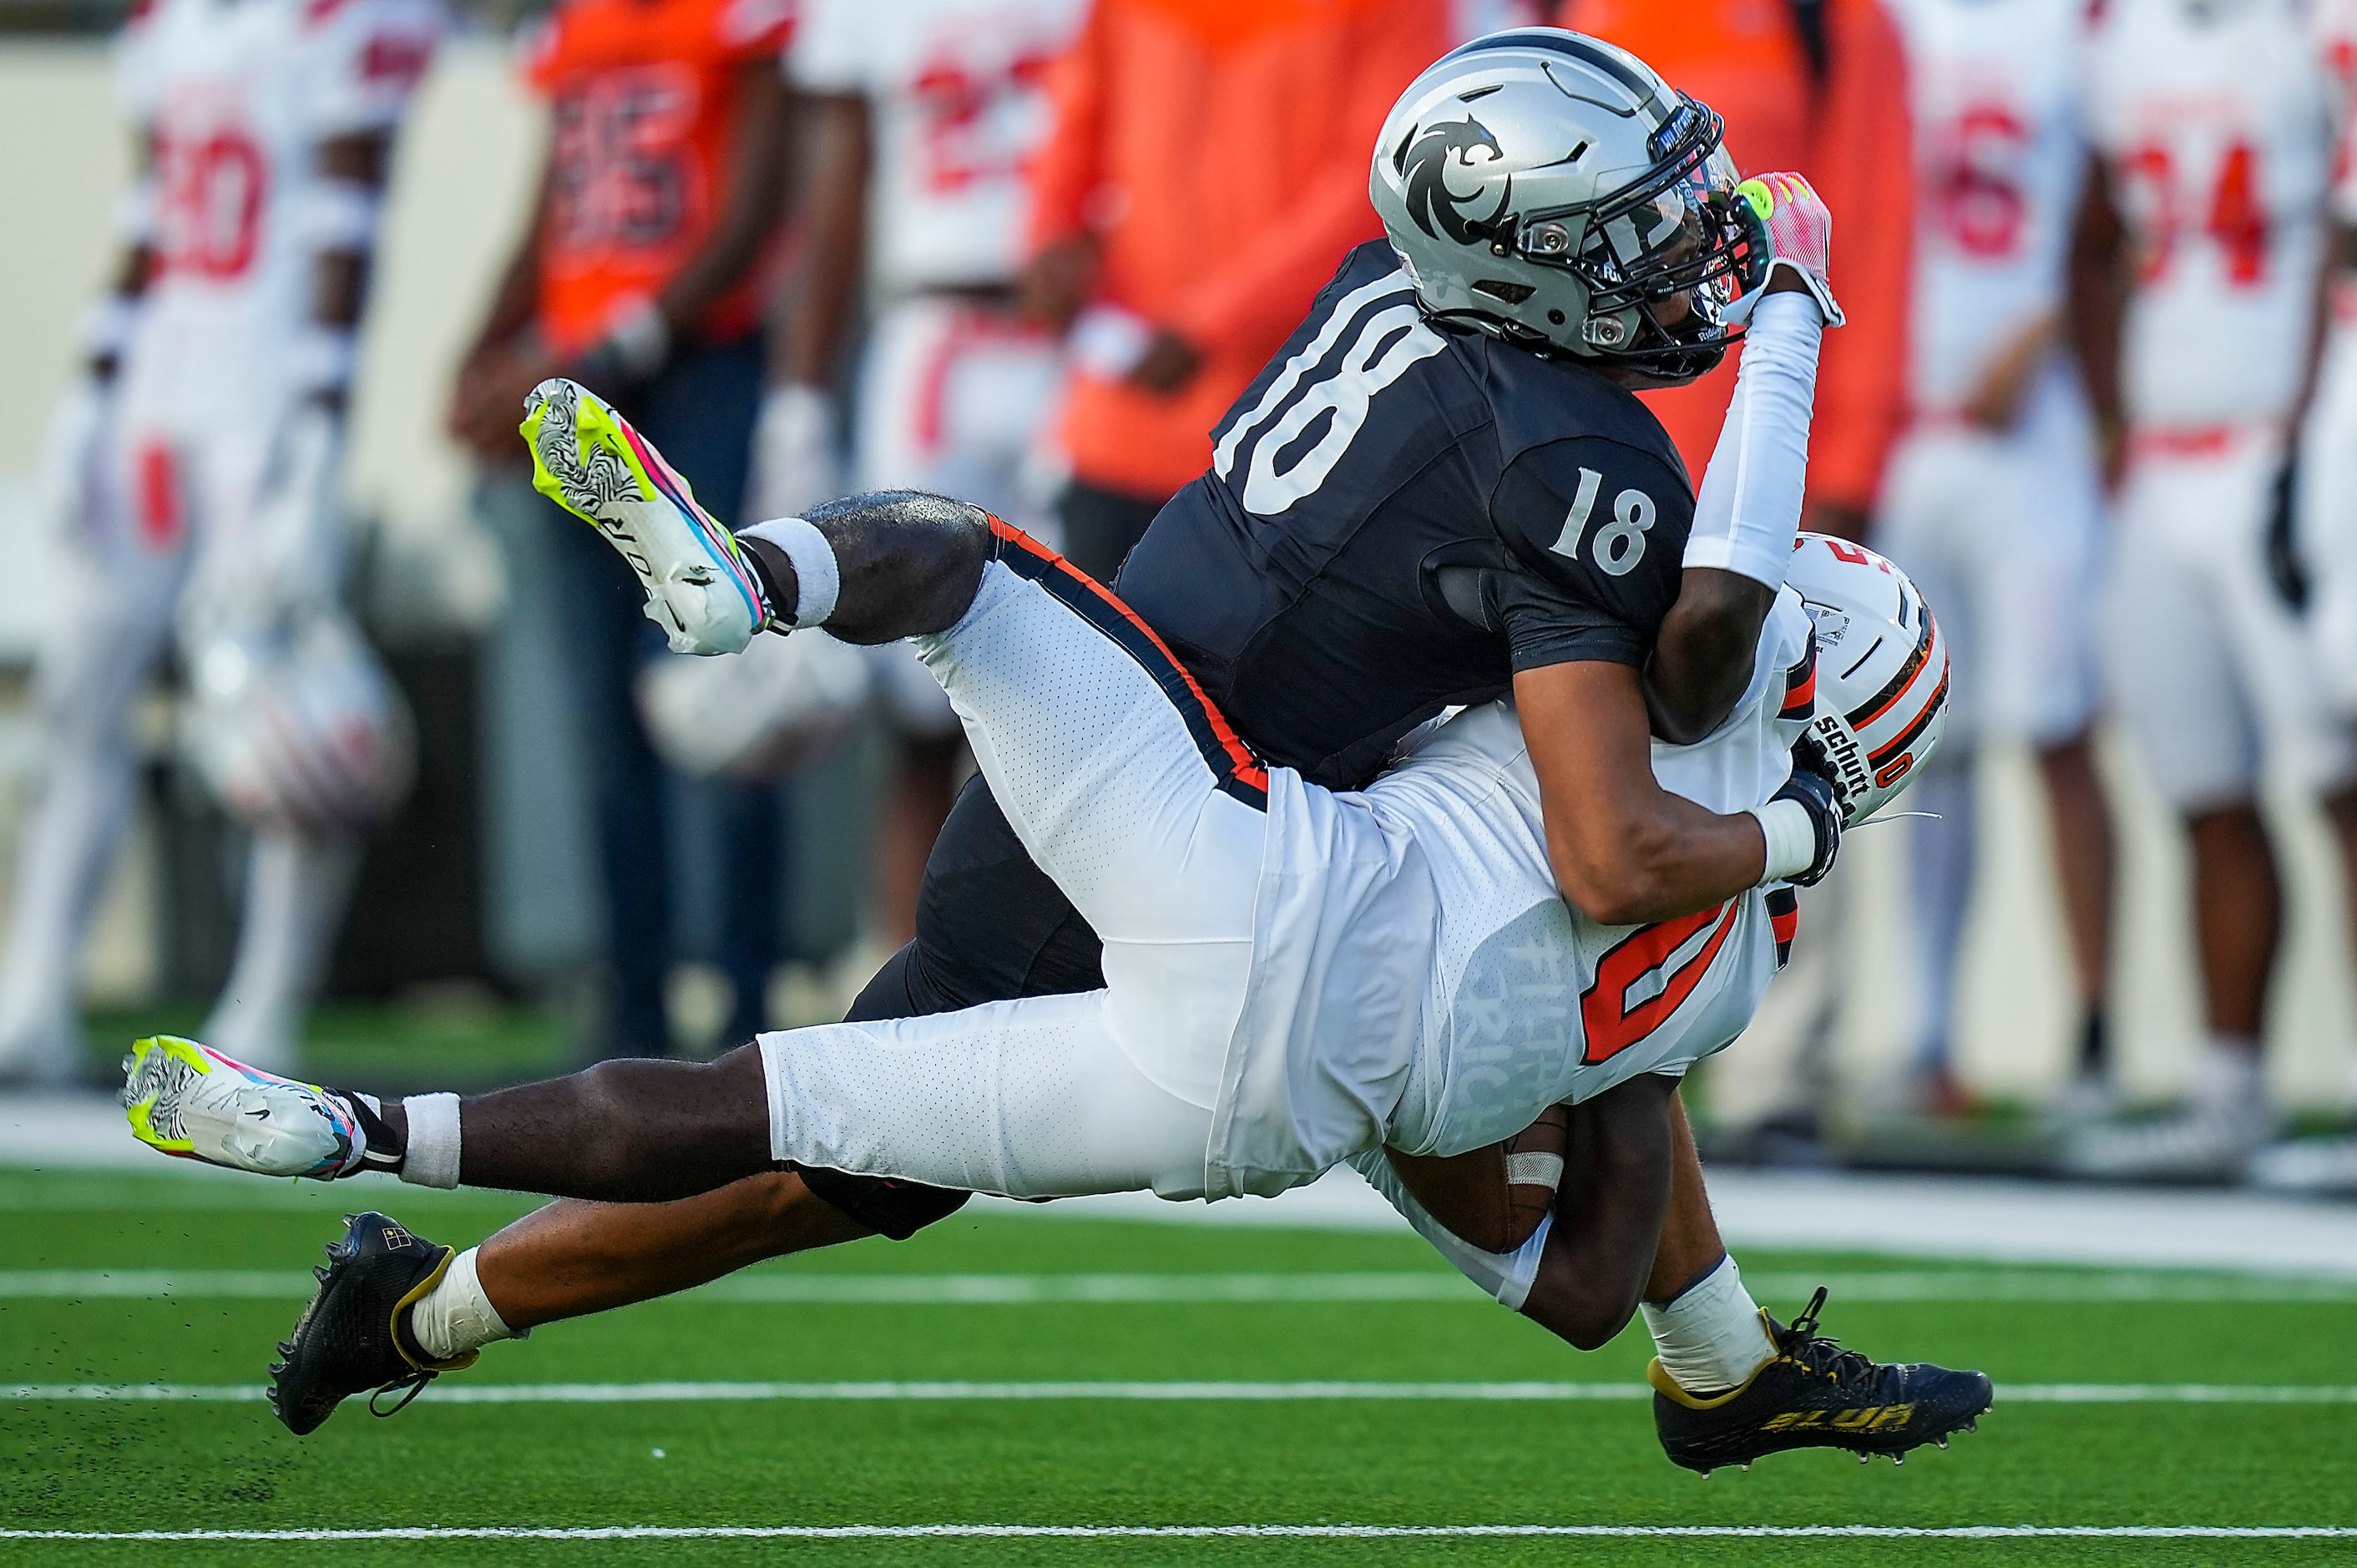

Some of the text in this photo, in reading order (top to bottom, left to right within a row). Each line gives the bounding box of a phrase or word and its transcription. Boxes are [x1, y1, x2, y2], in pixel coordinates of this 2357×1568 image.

[1212, 269, 1448, 514] 18
[1550, 467, 1656, 576] 18
[1815, 716, 1870, 798] schutt
[1874, 751, 1914, 789] 0
[1580, 896, 1739, 1066] 0
